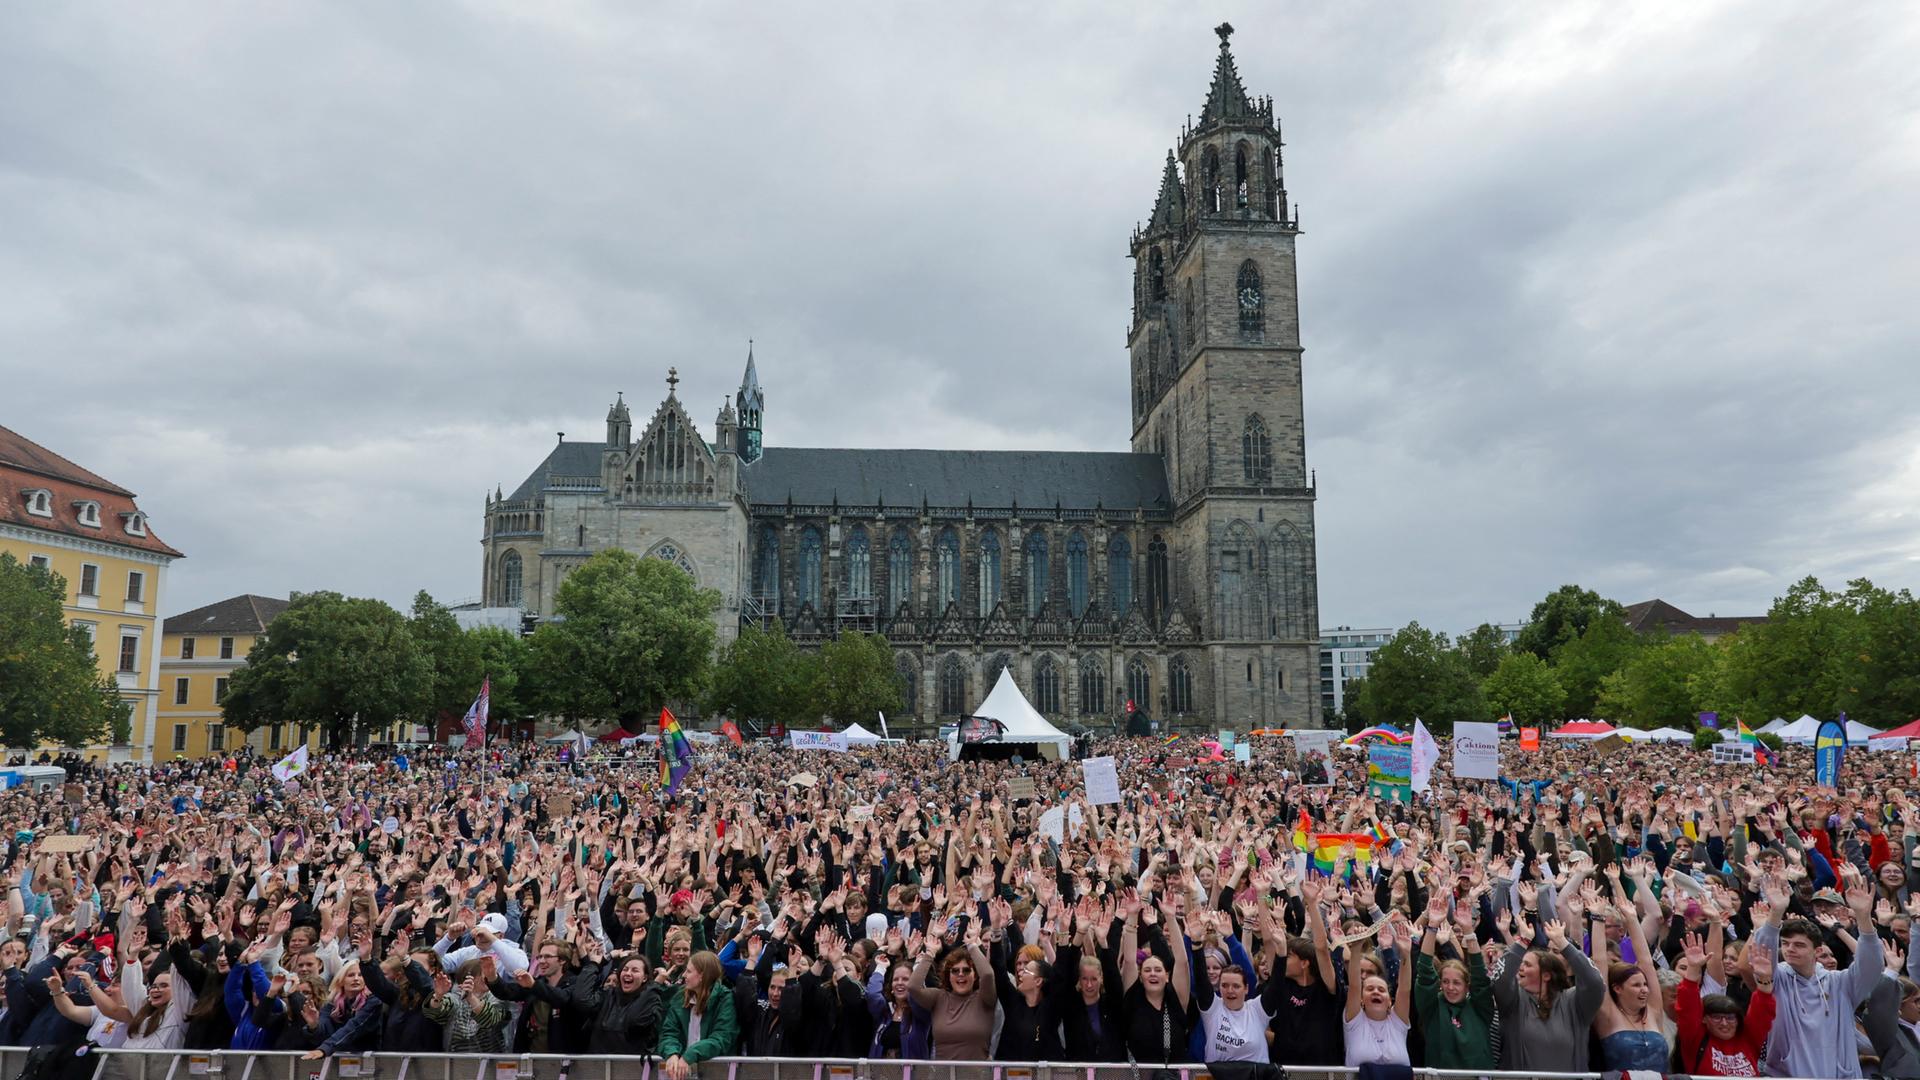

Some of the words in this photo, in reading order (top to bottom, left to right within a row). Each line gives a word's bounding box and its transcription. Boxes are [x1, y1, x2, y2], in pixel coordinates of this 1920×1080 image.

[796, 738, 816, 746] GEGEN
[805, 733, 831, 742] OMAS
[1464, 741, 1496, 750] aktions
[1216, 1031, 1245, 1047] BACKUP
